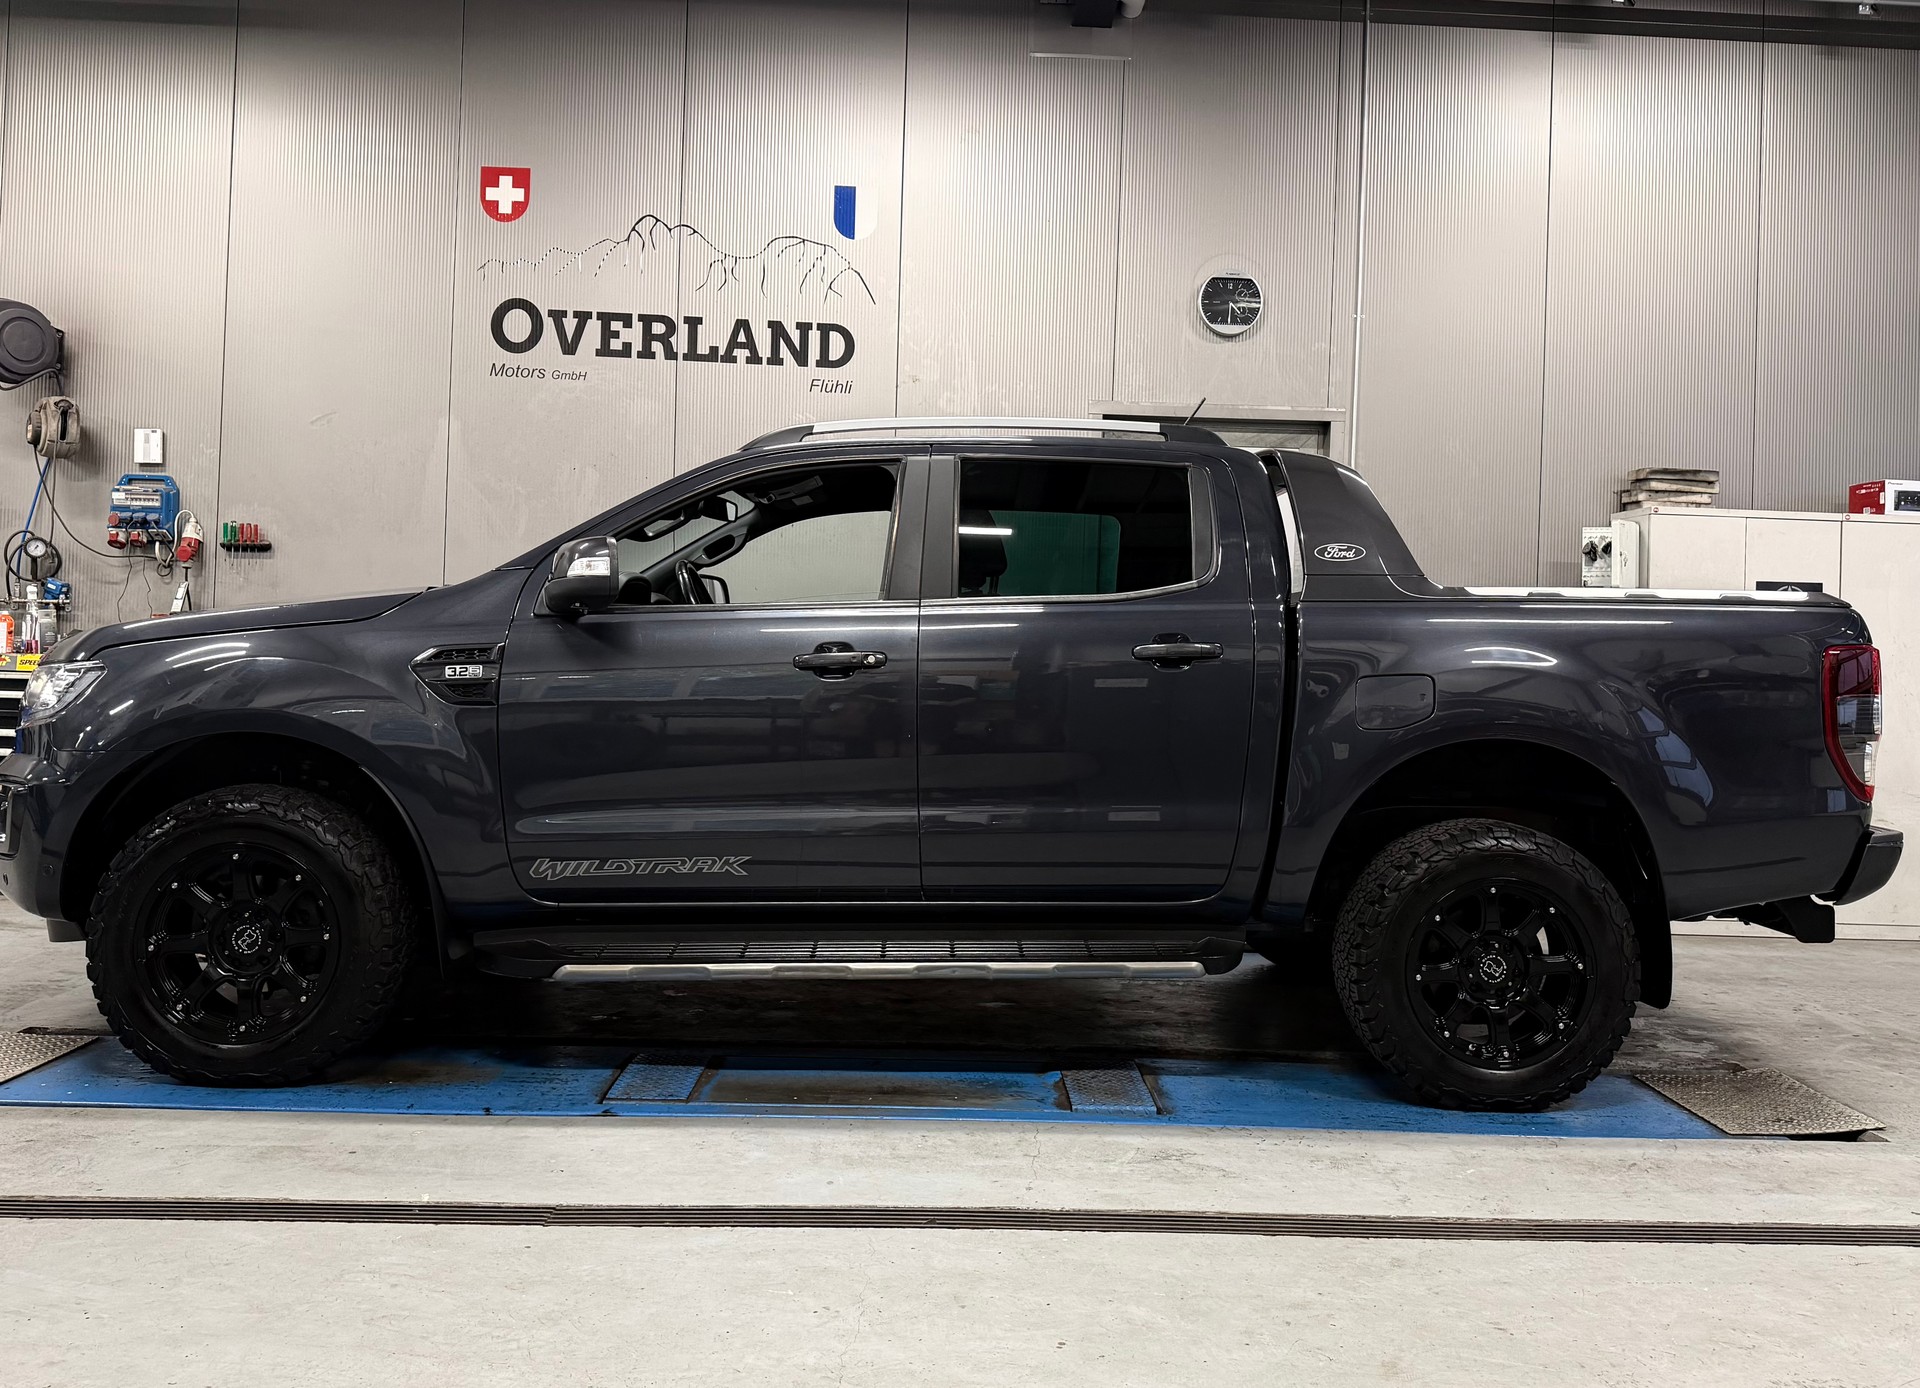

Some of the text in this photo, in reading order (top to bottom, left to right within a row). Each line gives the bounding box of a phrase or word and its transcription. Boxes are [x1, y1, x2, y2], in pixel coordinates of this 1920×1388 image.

[490, 363, 587, 381] Motors GmbH
[809, 379, 853, 394] Flühli
[1324, 546, 1356, 558] Ford
[447, 667, 468, 677] 3.2
[529, 856, 752, 880] WILDTRAK
